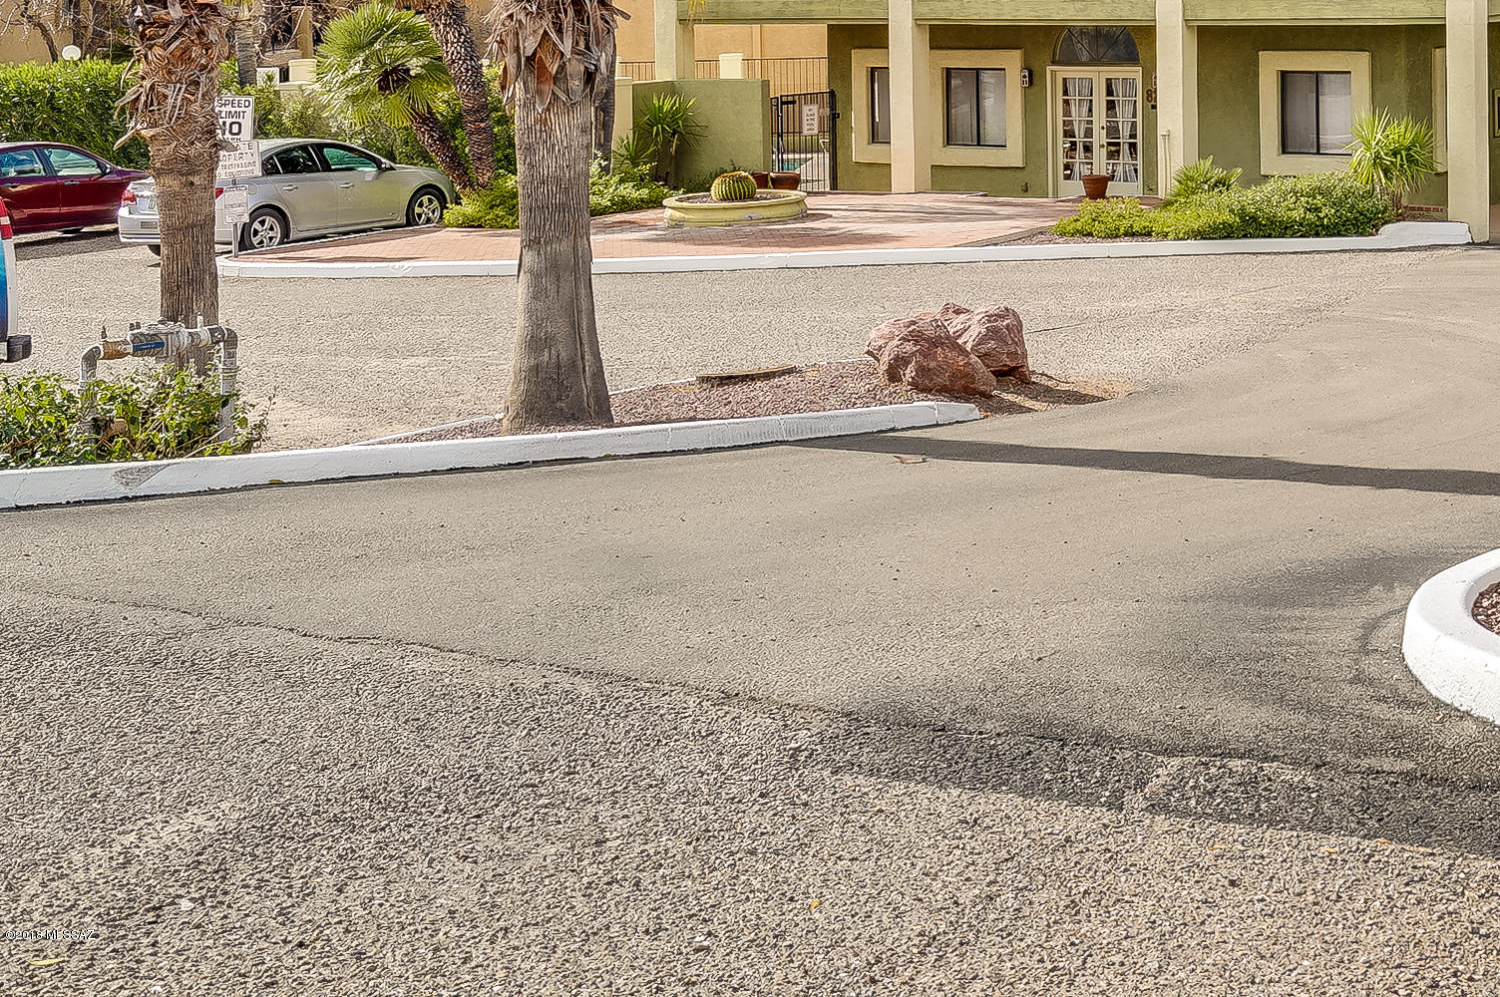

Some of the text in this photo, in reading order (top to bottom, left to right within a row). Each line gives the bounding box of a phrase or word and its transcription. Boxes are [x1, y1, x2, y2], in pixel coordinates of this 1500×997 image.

[216, 98, 251, 109] SPEED
[218, 110, 247, 120] LIMIT
[221, 121, 242, 136] 10
